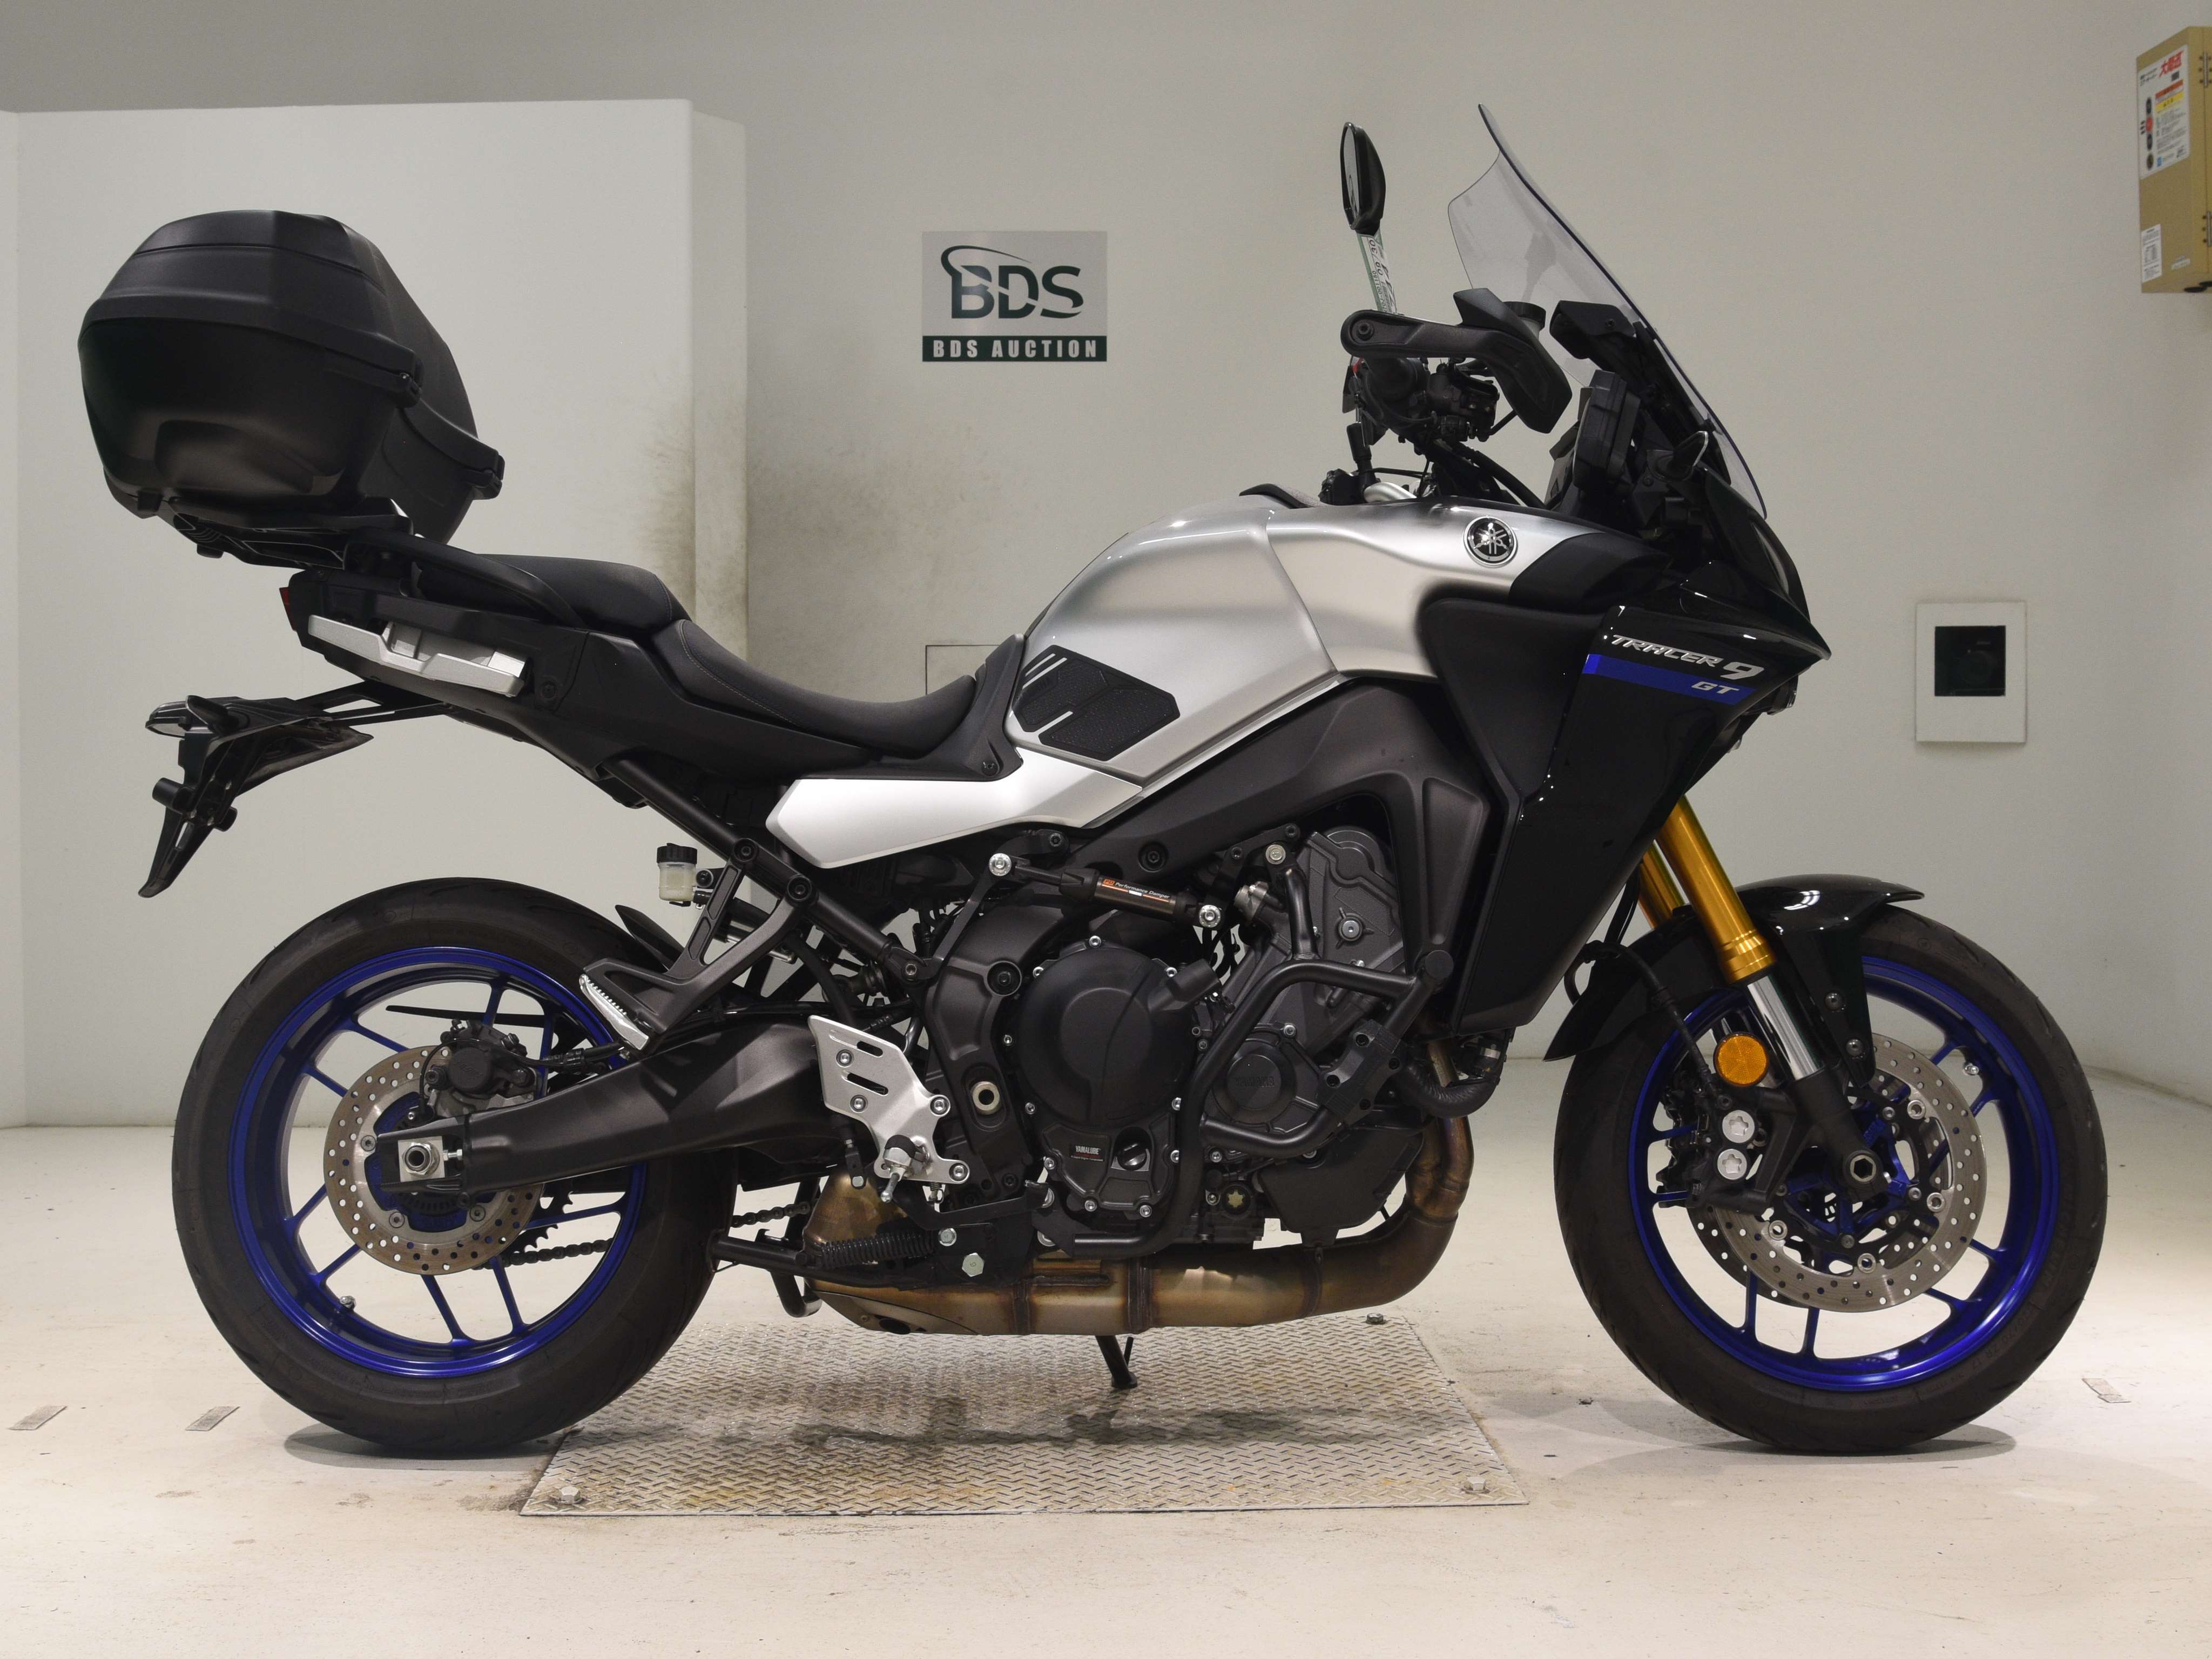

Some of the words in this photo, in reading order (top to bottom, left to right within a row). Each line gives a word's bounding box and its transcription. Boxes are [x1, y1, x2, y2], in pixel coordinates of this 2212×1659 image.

[941, 246, 1084, 319] BDS
[933, 340, 978, 358] BDS
[991, 340, 1096, 358] AUCTION
[1612, 634, 1724, 667] TRACER
[1720, 662, 1765, 680] 9
[1691, 681, 1739, 694] GT
[1115, 882, 1148, 894] Performance
[1149, 890, 1171, 899] Damper
[1075, 1145, 1100, 1155] YAMALUBE
